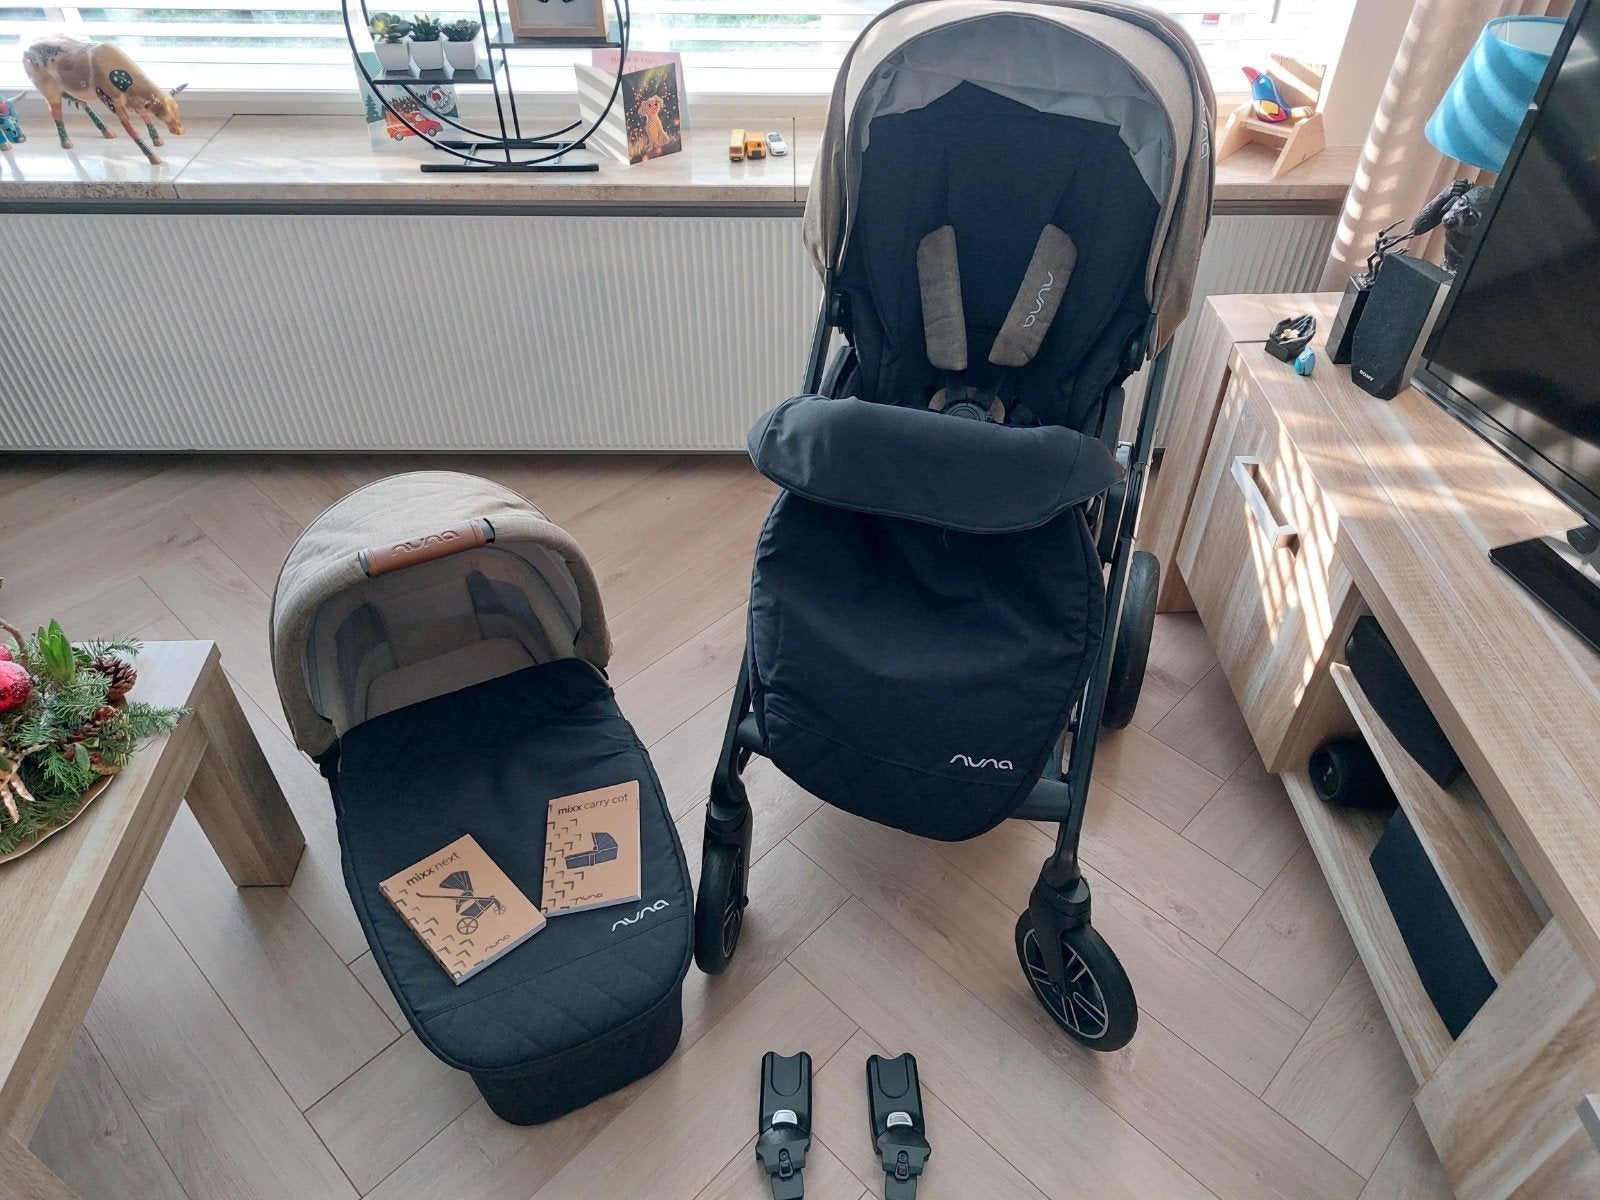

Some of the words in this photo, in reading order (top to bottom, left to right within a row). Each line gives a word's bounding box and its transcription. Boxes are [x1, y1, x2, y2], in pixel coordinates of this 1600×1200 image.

[1022, 270, 1054, 328] nuna
[1359, 369, 1375, 381] SONY
[391, 530, 460, 557] nuna
[949, 754, 1013, 770] nuna
[557, 804, 582, 816] mixx
[584, 798, 610, 810] carry
[612, 792, 628, 804] cot
[406, 867, 435, 887] mixx
[434, 852, 461, 870] next
[576, 892, 604, 902] nuna
[611, 899, 670, 932] nuna
[484, 934, 511, 953] nuna
